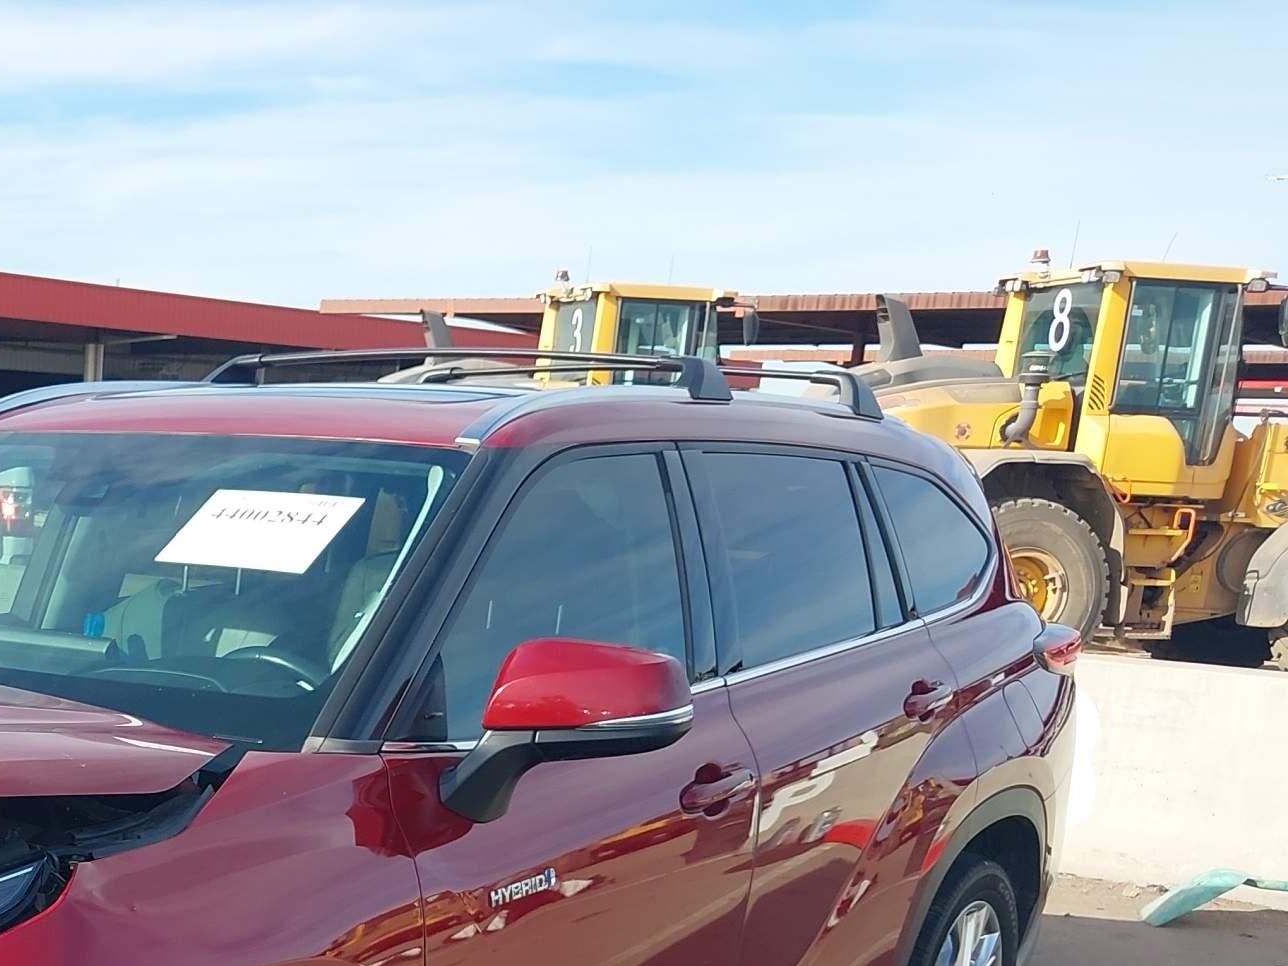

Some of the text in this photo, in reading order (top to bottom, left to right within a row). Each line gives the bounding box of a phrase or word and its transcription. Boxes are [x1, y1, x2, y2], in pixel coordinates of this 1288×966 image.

[569, 308, 583, 353] 3
[1048, 287, 1073, 352] 8
[490, 873, 549, 908] HYBRID
